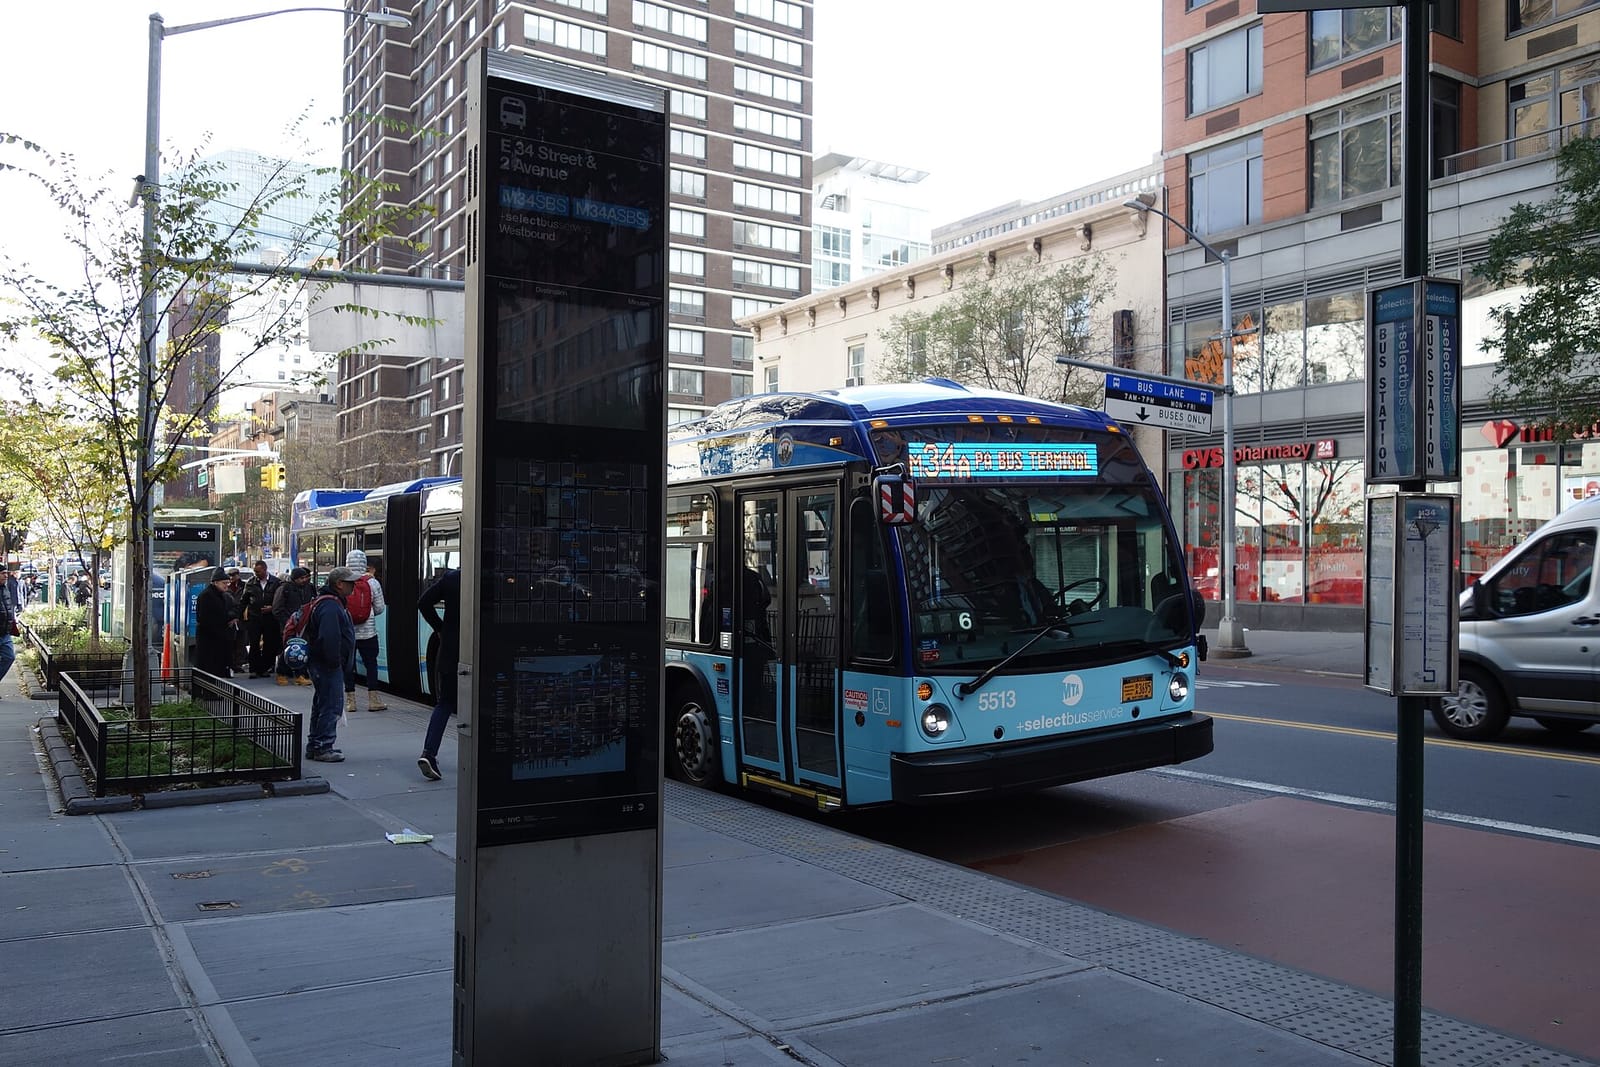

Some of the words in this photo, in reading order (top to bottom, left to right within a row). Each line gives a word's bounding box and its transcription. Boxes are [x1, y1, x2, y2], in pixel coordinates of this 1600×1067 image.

[501, 139, 511, 153] E
[515, 141, 534, 157] 34
[537, 146, 583, 167] Street
[586, 155, 598, 170] &
[500, 157, 509, 170] 2
[513, 158, 568, 181] Avenue
[575, 202, 647, 226] M34ASBS
[499, 224, 555, 241] Westbound
[1379, 328, 1387, 369] BUS
[1426, 320, 1434, 360] BUS
[1137, 382, 1153, 393] BUS
[1164, 386, 1185, 399] LANE
[1159, 409, 1184, 421] BUSES
[1187, 414, 1207, 425] ONLY
[1379, 377, 1387, 473] STATION
[1182, 447, 1223, 469] CVS
[1233, 442, 1312, 464] pharmacy
[1318, 441, 1332, 451] 24
[975, 451, 992, 471] PA
[998, 451, 1023, 471] BUS
[1029, 451, 1092, 471] TERMINAL
[958, 612, 972, 630] 6
[845, 690, 868, 700] CAUTION
[978, 690, 1017, 712] 5513
[1016, 705, 1123, 732] +selectbusservice
